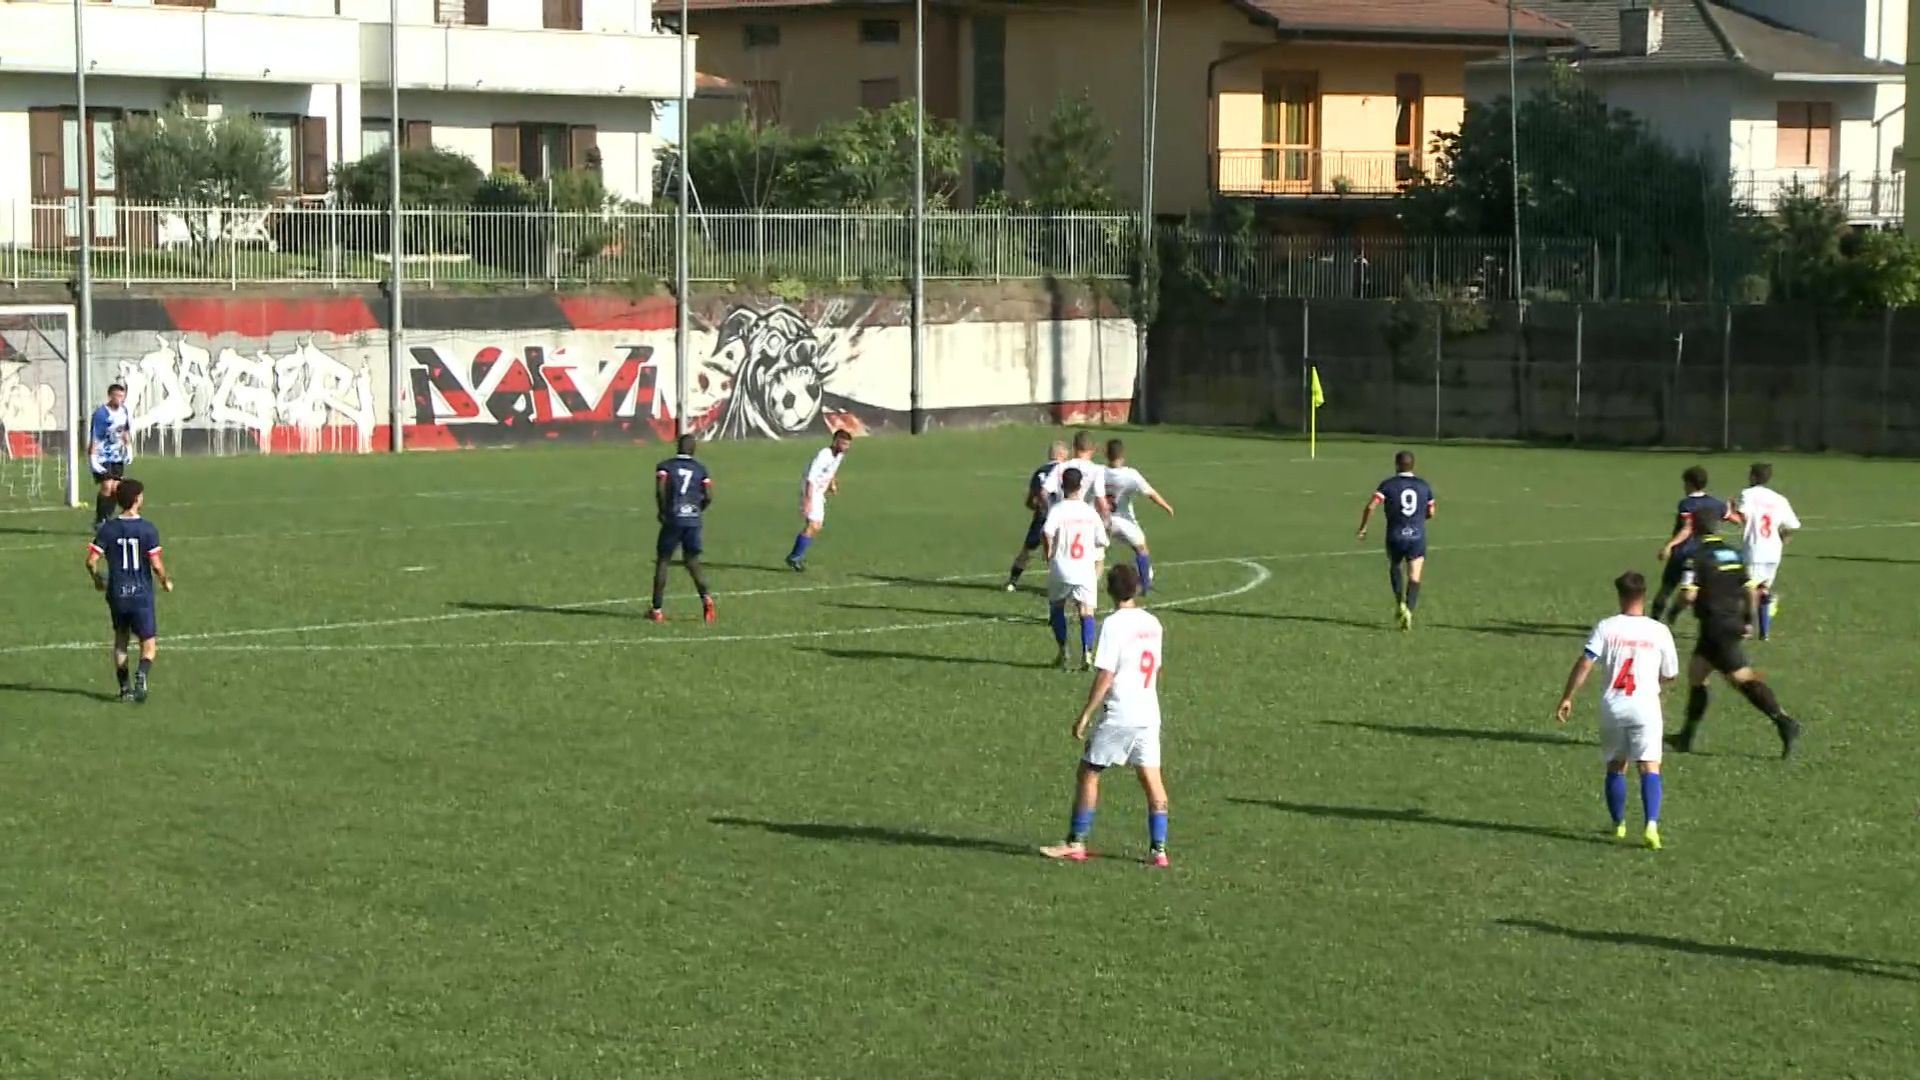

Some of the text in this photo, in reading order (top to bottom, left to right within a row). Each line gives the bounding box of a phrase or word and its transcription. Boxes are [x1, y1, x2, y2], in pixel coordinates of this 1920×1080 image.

[678, 468, 694, 494] 7
[1401, 489, 1418, 516] 9
[117, 538, 139, 570] 11
[1071, 533, 1084, 559] 6
[1140, 650, 1155, 688] 9
[1612, 658, 1636, 696] 4
